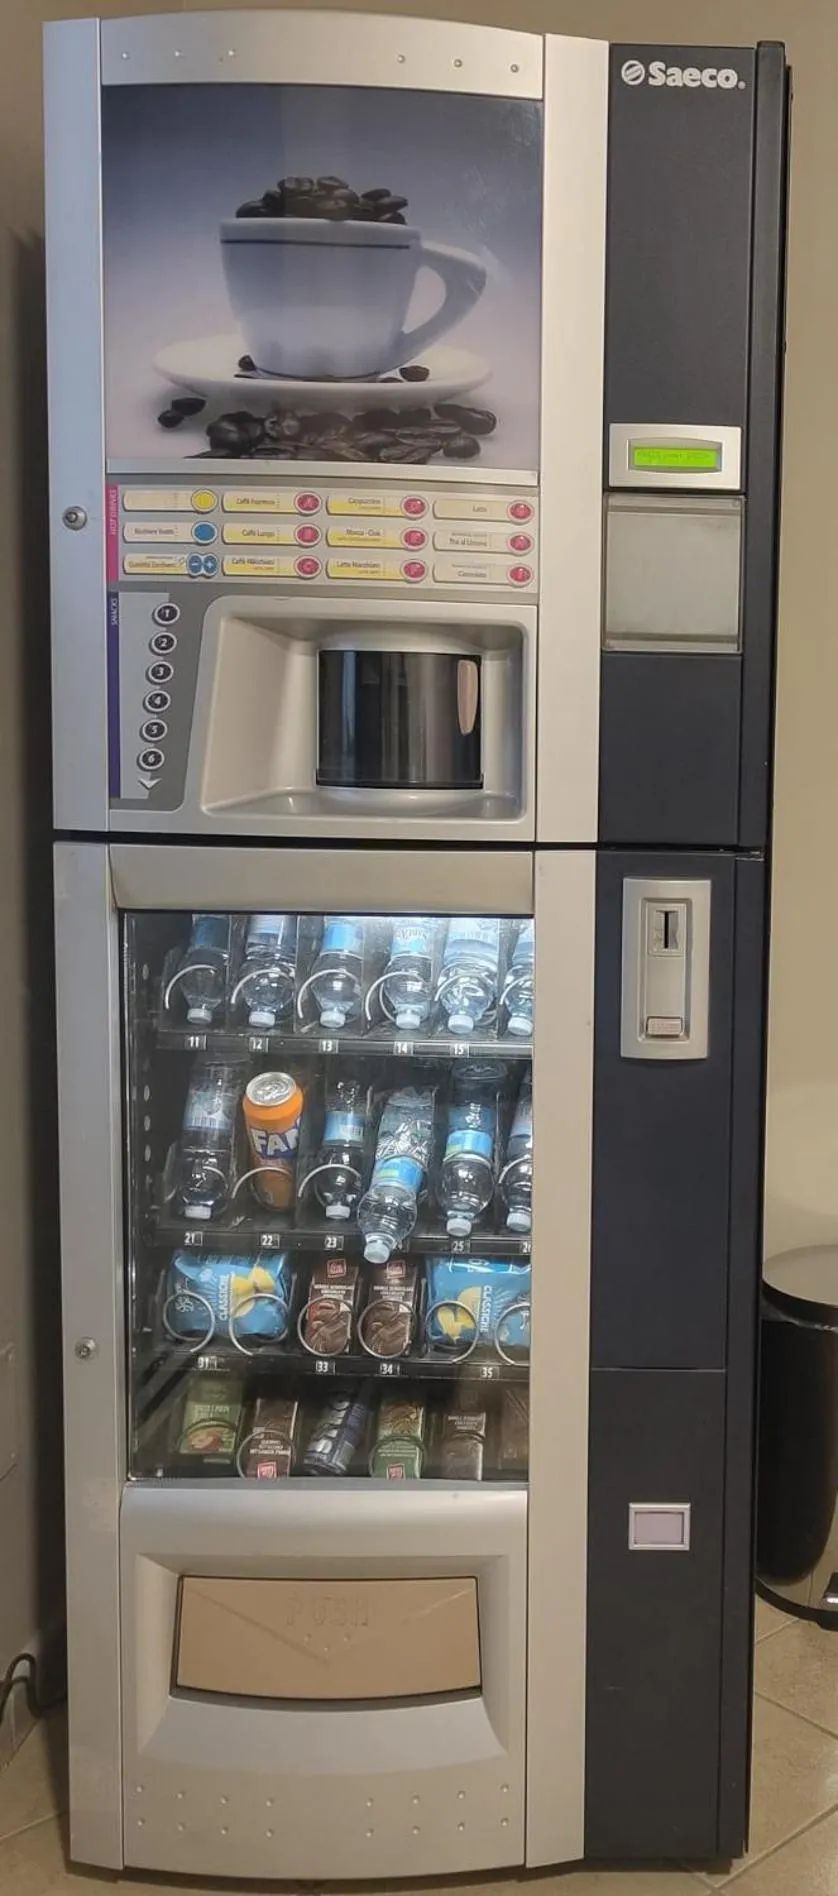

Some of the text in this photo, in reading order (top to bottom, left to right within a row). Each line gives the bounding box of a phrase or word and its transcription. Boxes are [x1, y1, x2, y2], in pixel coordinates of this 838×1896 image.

[648, 61, 738, 89] Saeco
[188, 1036, 200, 1047] 11
[252, 1038, 263, 1049] 12
[321, 1041, 333, 1051] 13
[397, 1043, 408, 1053] 14
[454, 1045, 465, 1055] 15
[184, 1232, 195, 1244] 21
[261, 1235, 273, 1246] 22
[326, 1237, 337, 1248] 23
[452, 1240, 464, 1251] 25
[316, 1361, 328, 1372] 33
[382, 1363, 393, 1375] 34
[481, 1367, 493, 1378] 35
